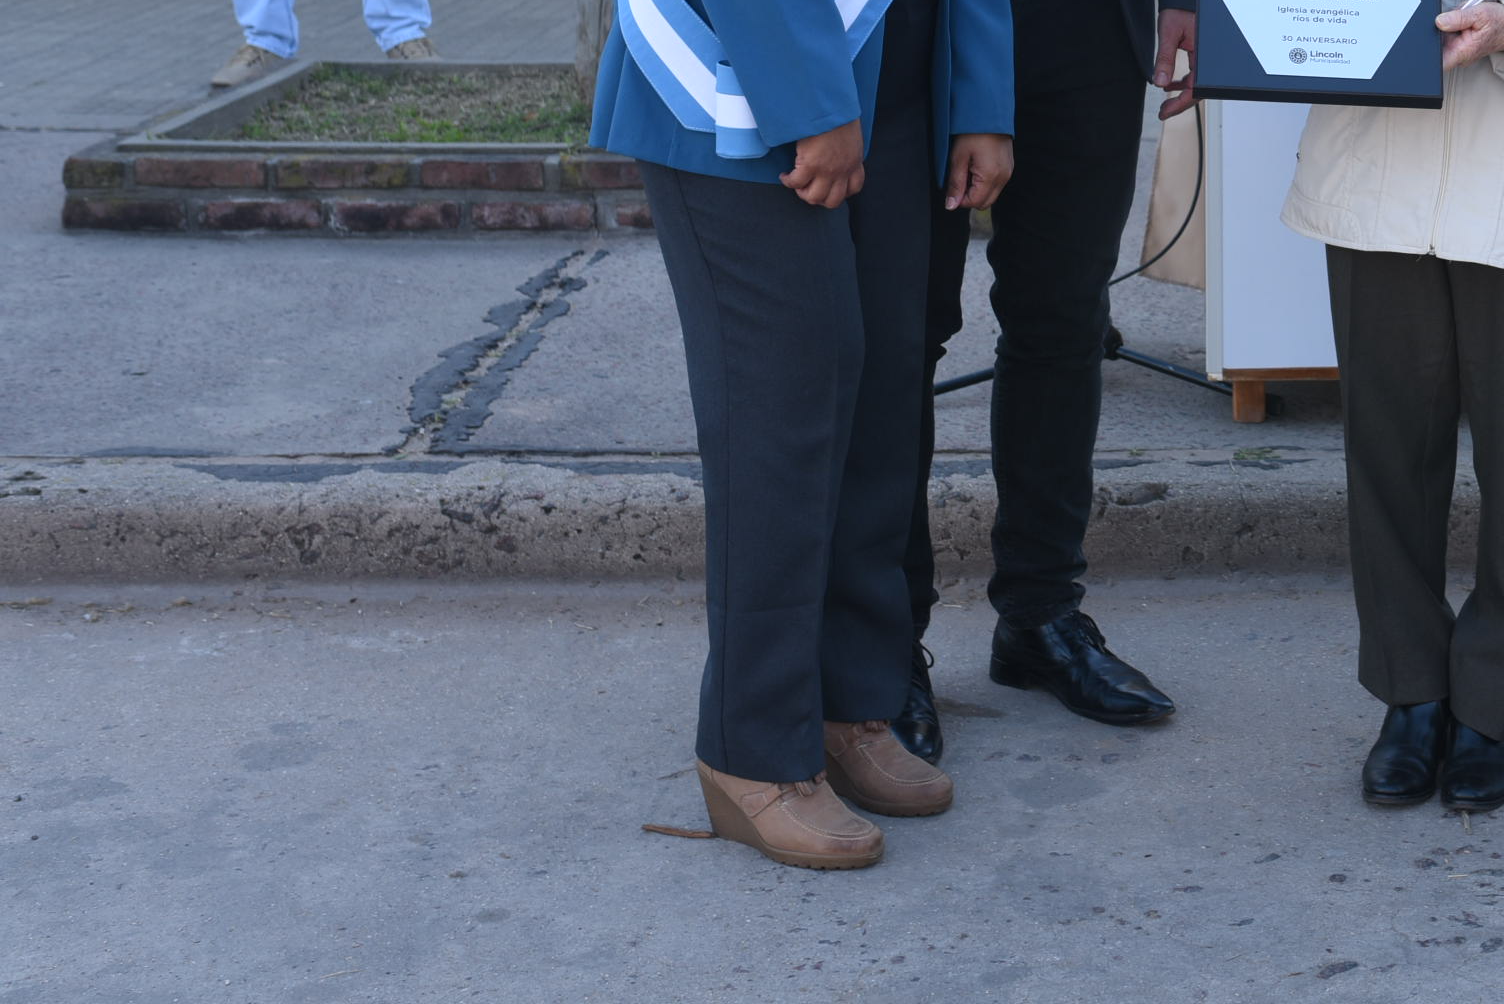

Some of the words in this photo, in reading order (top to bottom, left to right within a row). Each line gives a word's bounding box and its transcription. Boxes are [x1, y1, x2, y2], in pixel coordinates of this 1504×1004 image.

[1277, 6, 1308, 14] Iglesia
[1310, 8, 1360, 17] evangélica
[1296, 36, 1358, 45] ANIVERSARIO
[1310, 50, 1343, 59] Lincoln
